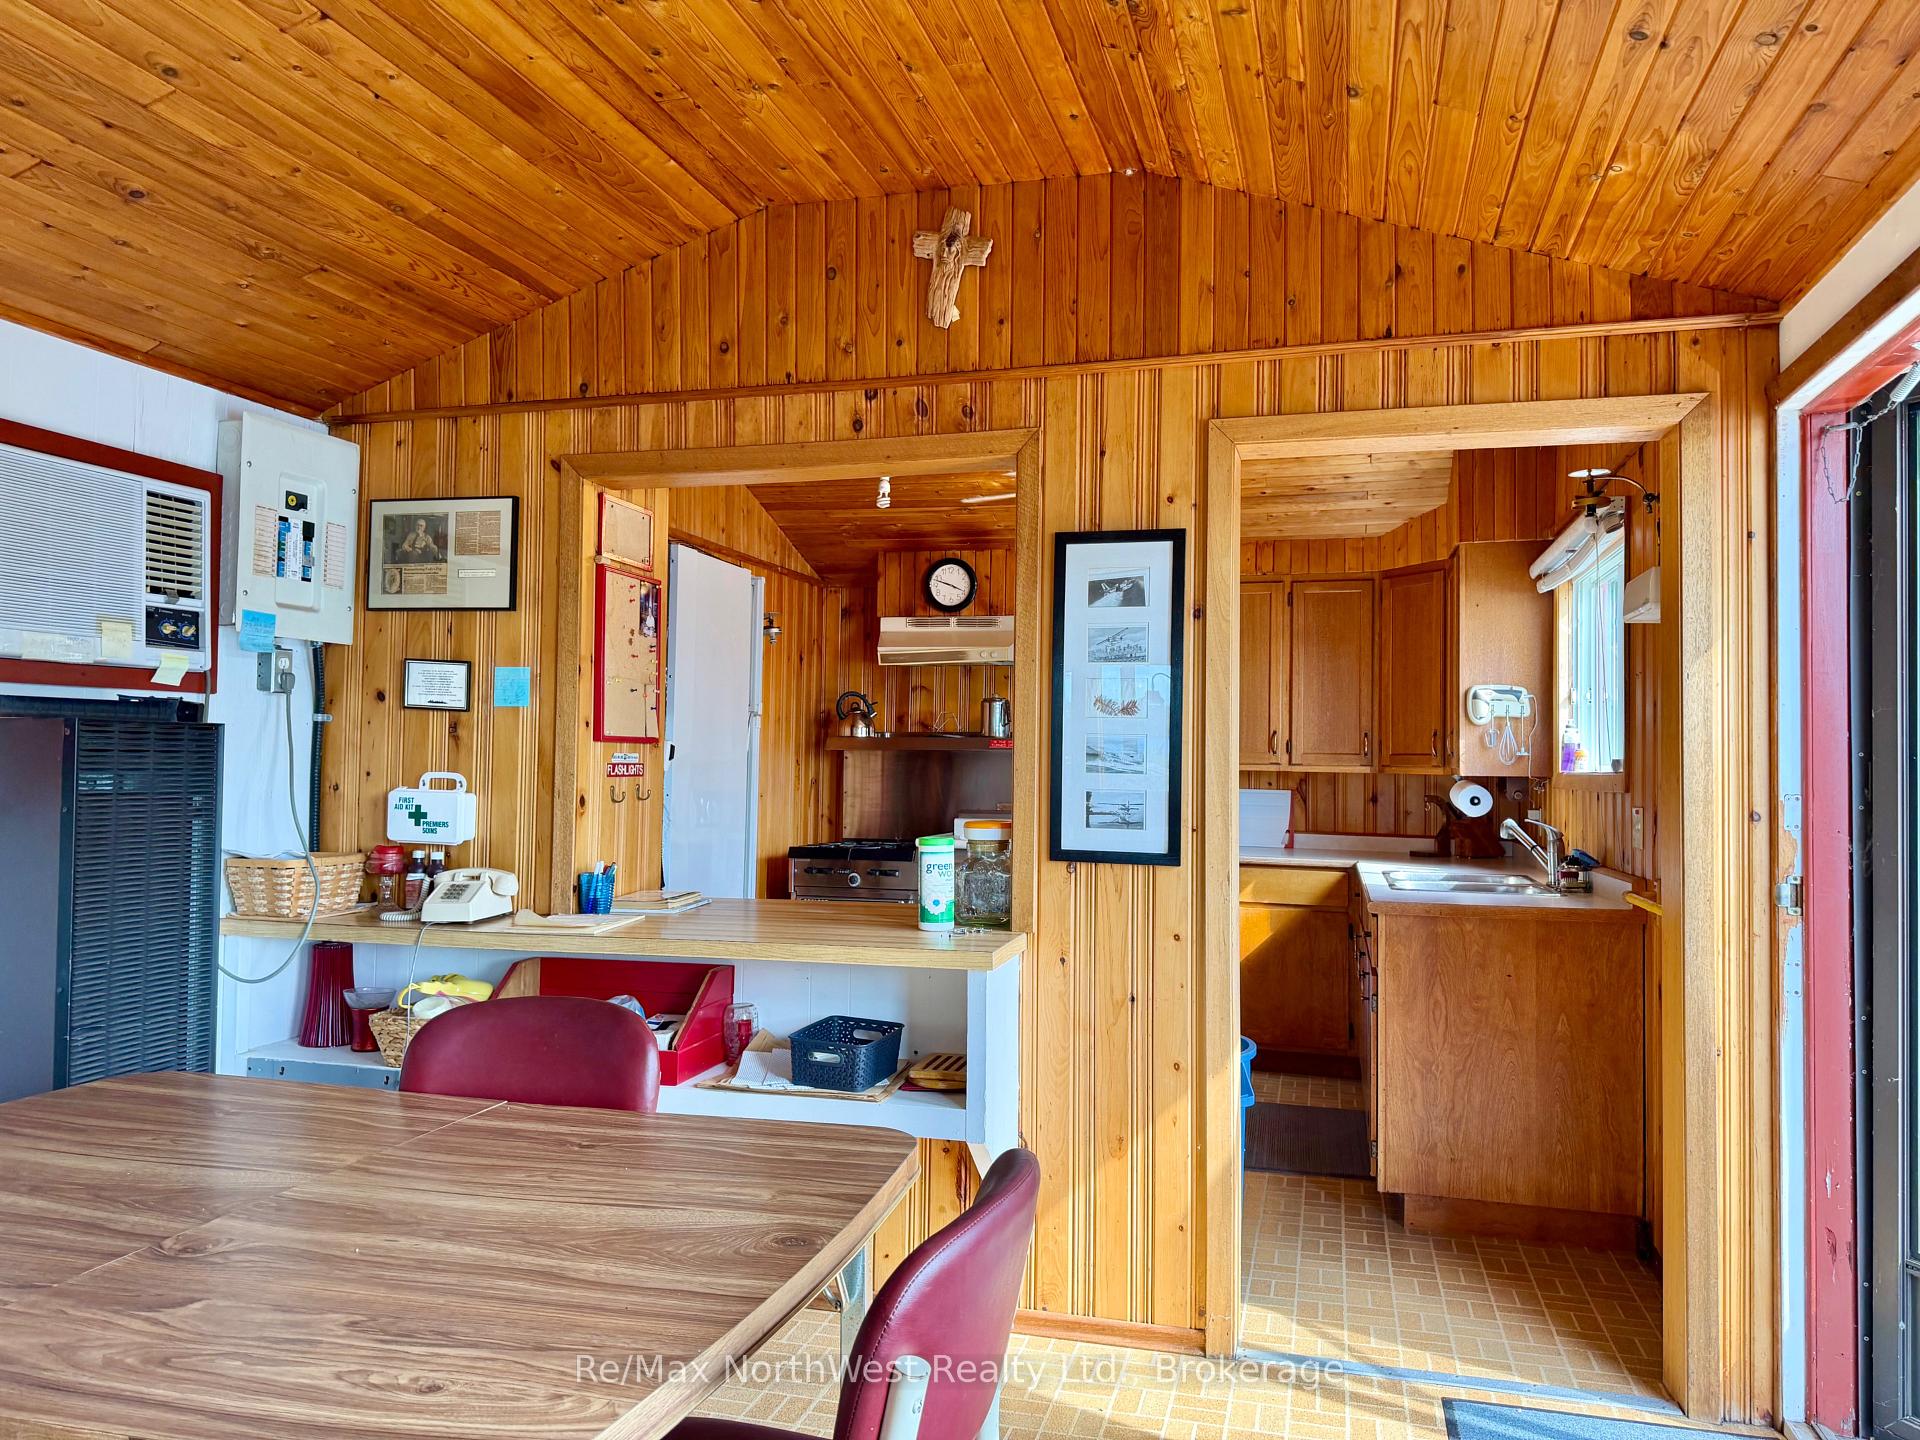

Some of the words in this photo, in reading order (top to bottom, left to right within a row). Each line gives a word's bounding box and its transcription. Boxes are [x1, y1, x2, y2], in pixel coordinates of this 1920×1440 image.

[607, 764, 644, 776] FLASHLIGHTS
[398, 796, 415, 804] FIRST
[422, 820, 449, 828] PREMIERS
[925, 863, 953, 874] green
